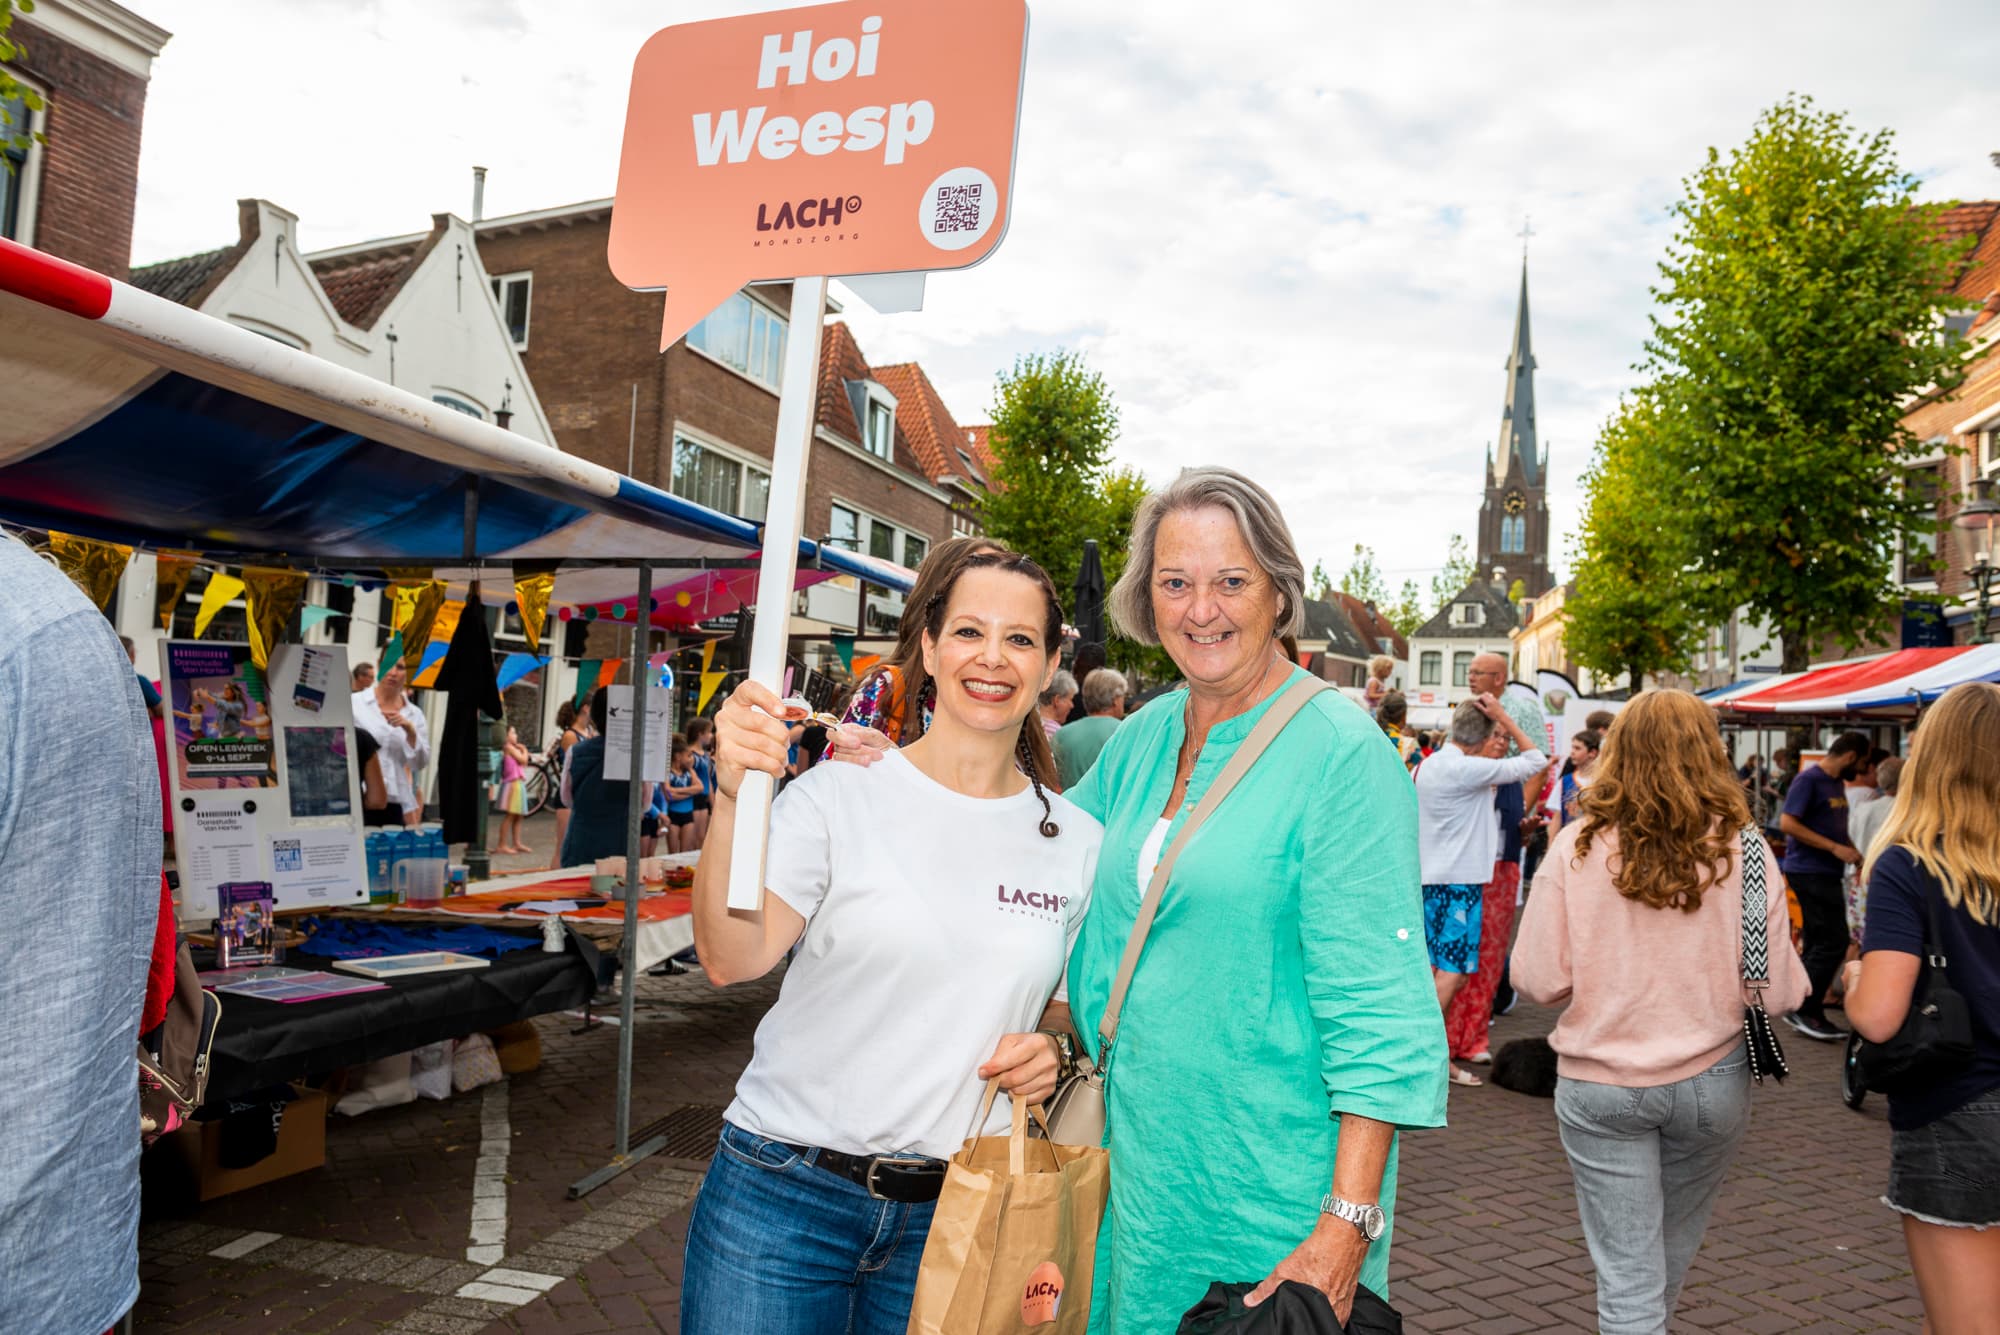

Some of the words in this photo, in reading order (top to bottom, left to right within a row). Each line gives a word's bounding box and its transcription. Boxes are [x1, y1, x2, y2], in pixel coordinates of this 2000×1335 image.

[757, 15, 883, 89] Hoi
[692, 100, 935, 166] Weesp
[754, 233, 860, 247] MONDZORG
[188, 744, 218, 753] OPEN
[219, 743, 267, 752] LESWEEK
[206, 754, 225, 763] 9-14
[226, 753, 252, 762] SEPT
[1025, 1281, 1060, 1300] LACH
